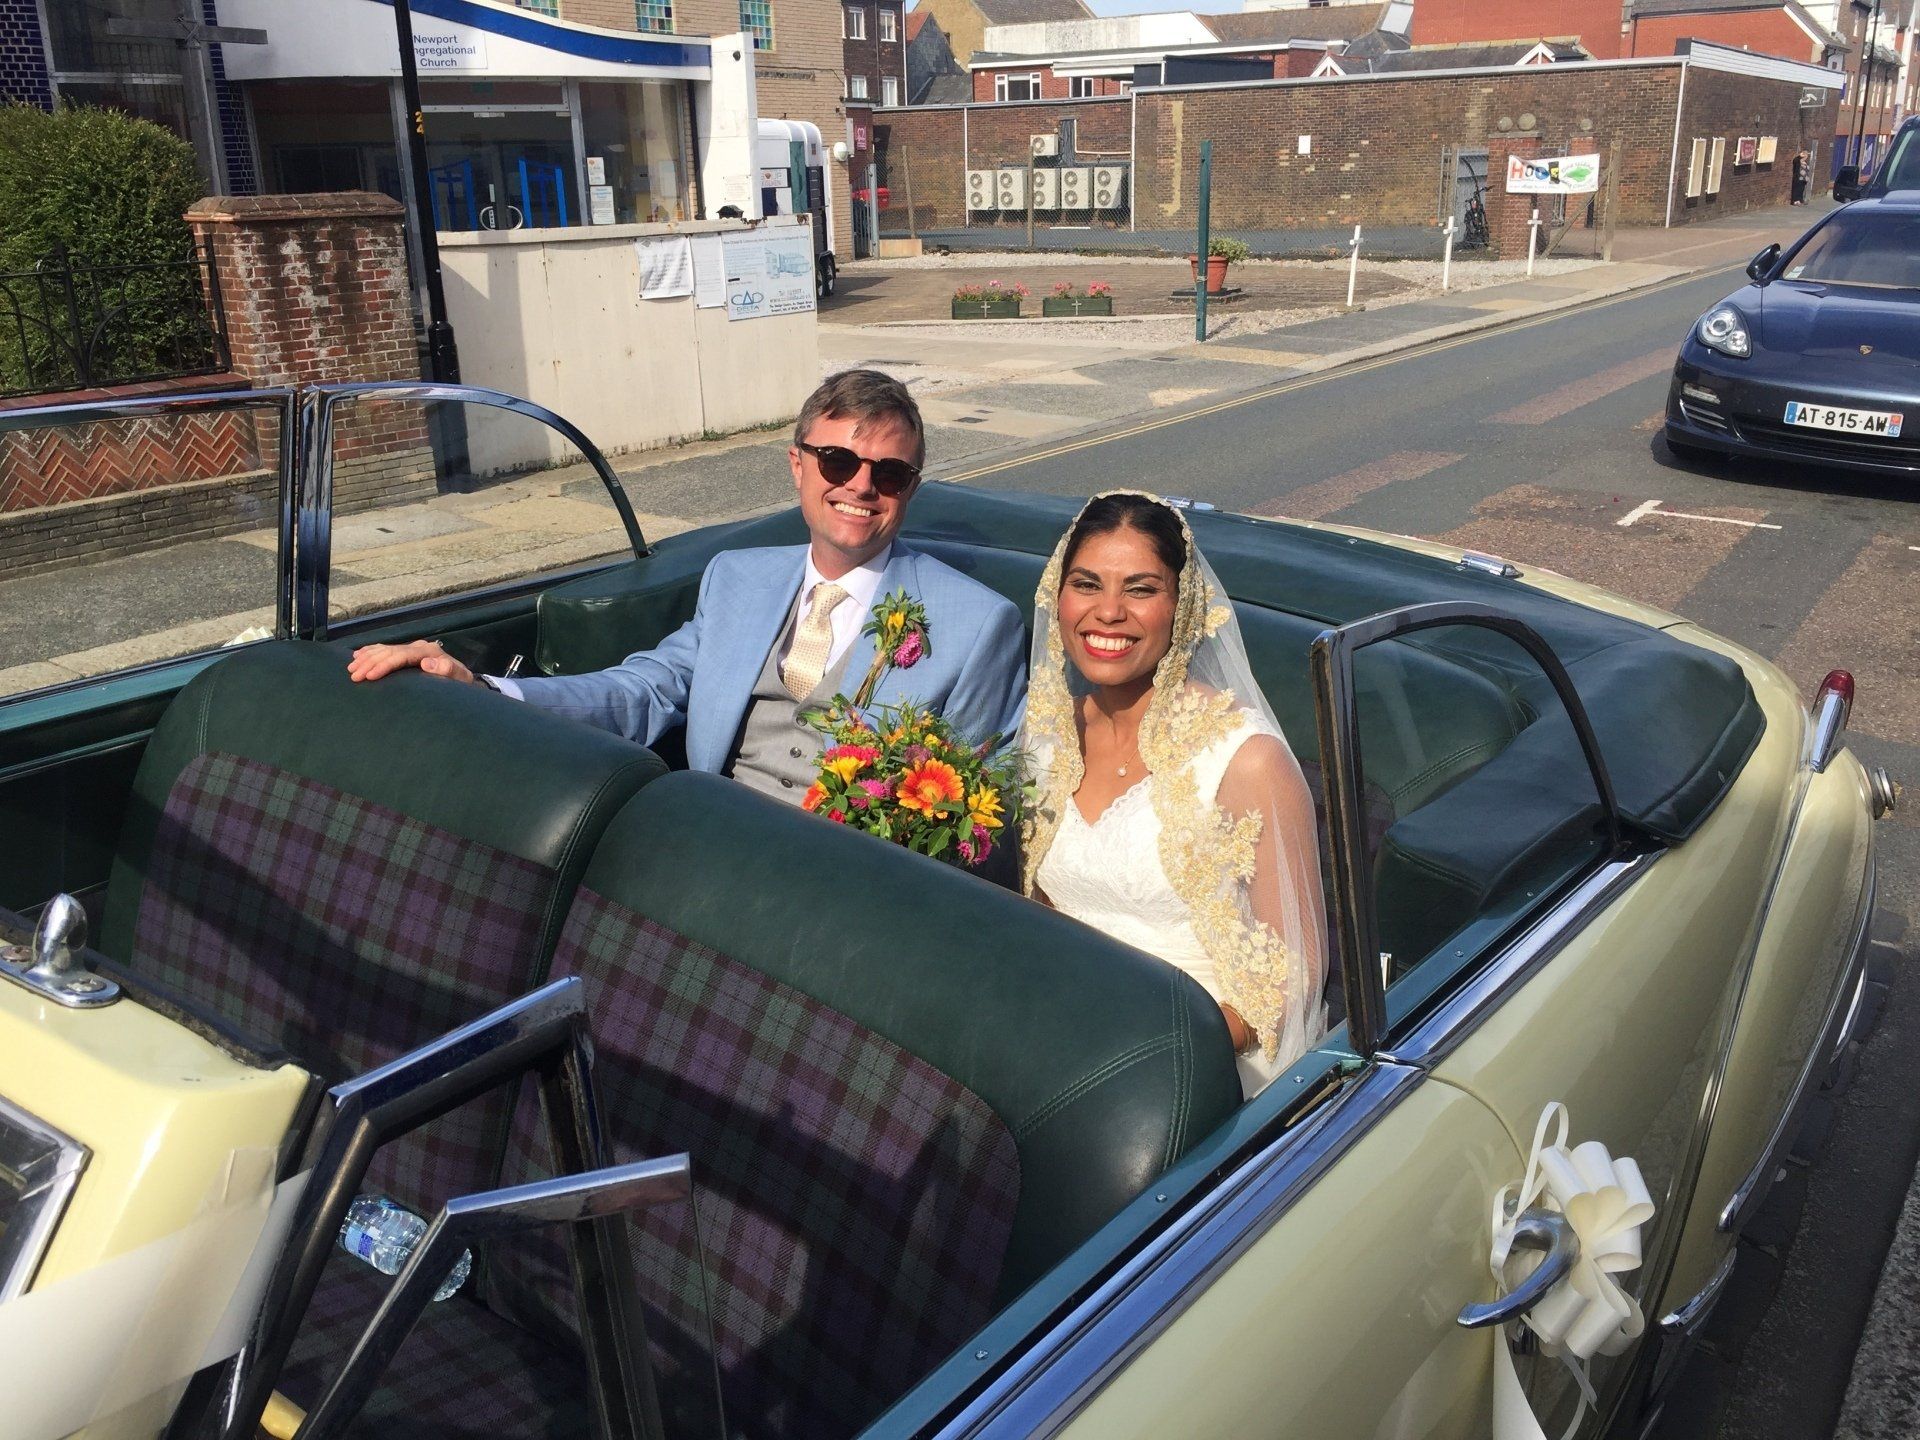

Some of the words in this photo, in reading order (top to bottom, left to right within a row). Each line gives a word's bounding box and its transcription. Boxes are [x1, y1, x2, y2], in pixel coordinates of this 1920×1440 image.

[413, 34, 458, 45] Newport
[414, 45, 476, 56] ngregational
[420, 58, 457, 67] Church
[1888, 425, 1899, 435] 46
